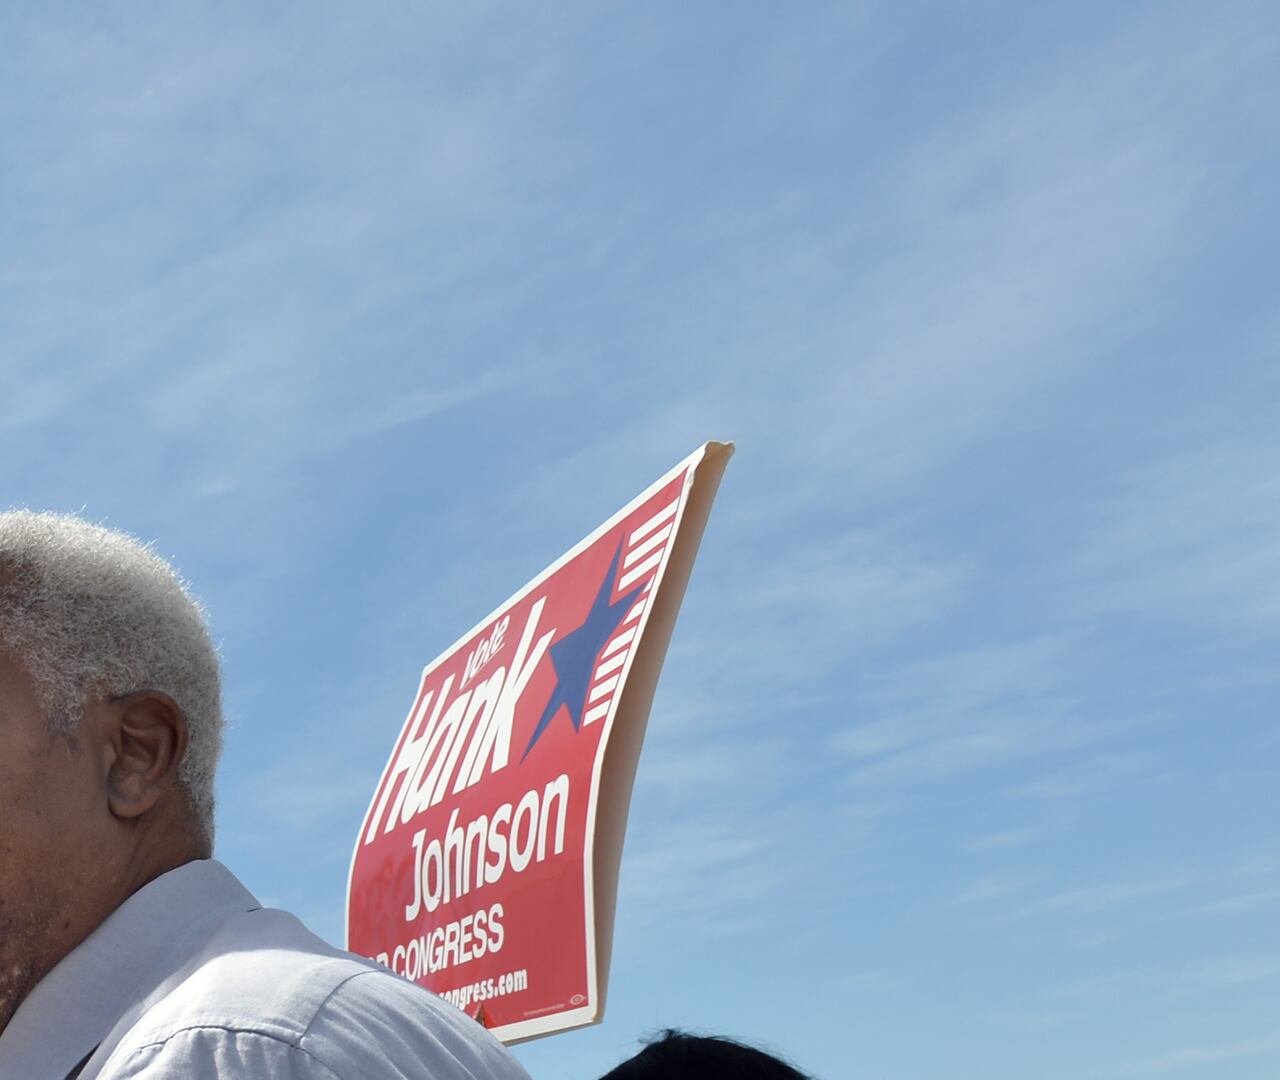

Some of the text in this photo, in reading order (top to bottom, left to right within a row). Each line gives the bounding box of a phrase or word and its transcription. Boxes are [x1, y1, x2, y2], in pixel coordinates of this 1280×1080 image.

[459, 615, 510, 690] Vote
[365, 596, 557, 845] Hank
[405, 773, 570, 922] Johnson
[393, 903, 504, 982] CONGRESS
[439, 968, 528, 1011] ongress.com
